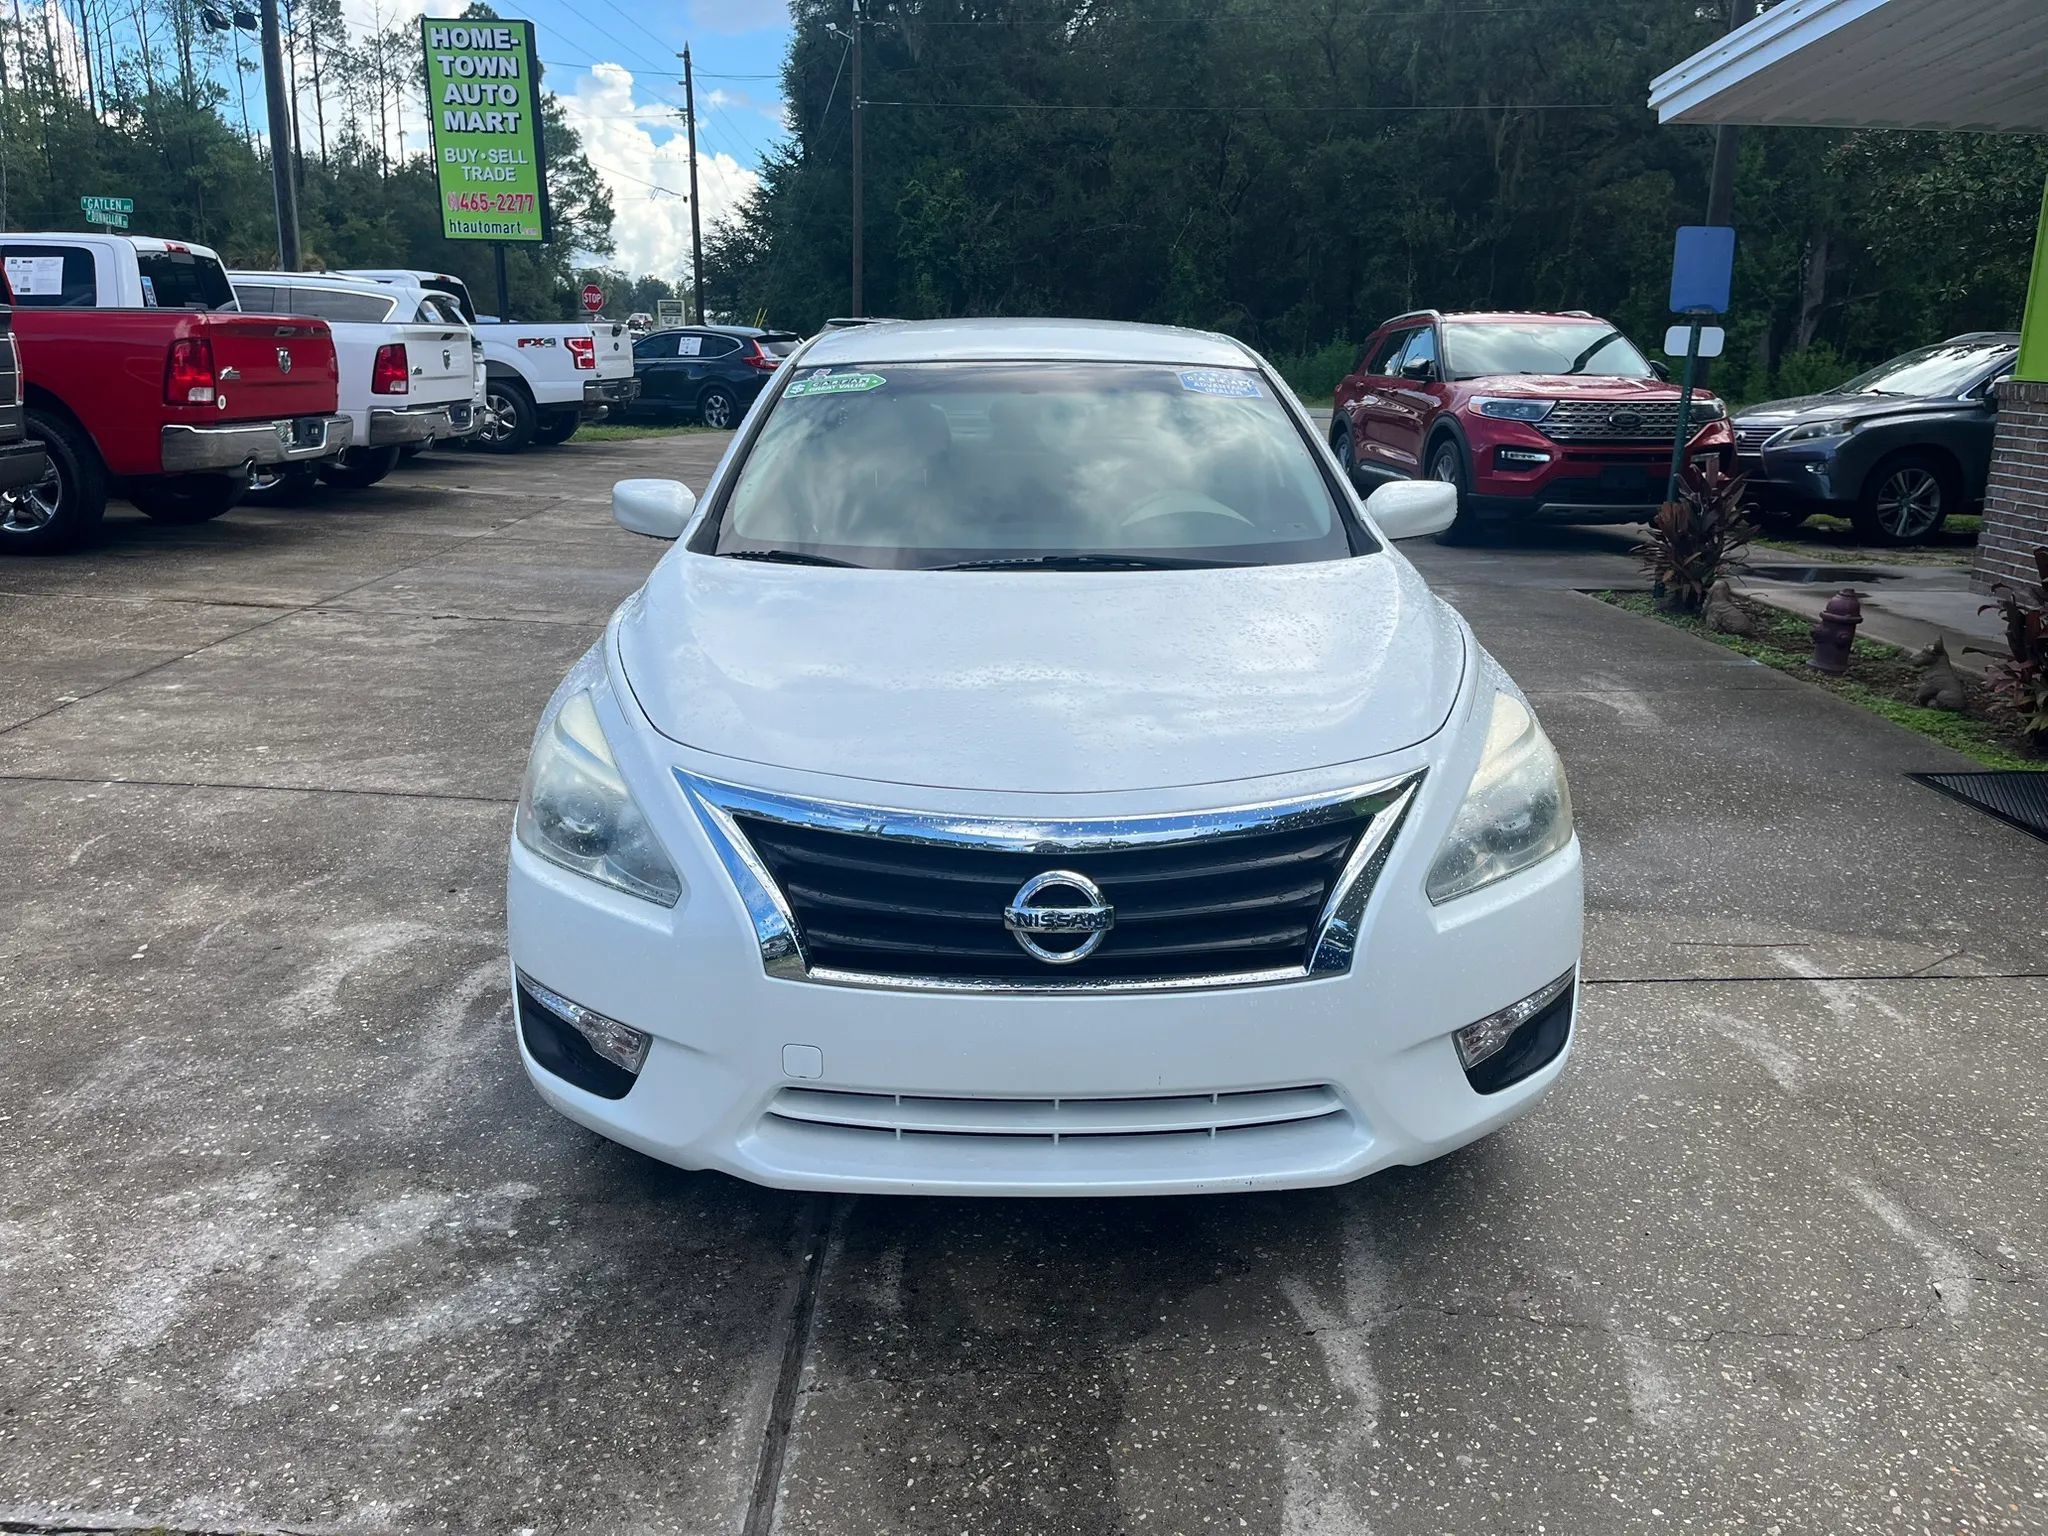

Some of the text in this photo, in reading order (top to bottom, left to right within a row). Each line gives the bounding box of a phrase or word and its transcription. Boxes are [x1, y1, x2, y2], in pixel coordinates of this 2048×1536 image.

[430, 27, 520, 50] HOME-
[437, 55, 519, 78] TOWN
[443, 83, 518, 106] AUTO
[443, 110, 521, 134] MART
[461, 166, 517, 182] TRADE
[88, 199, 121, 210] GATLEN
[583, 292, 602, 304] STOP
[517, 337, 557, 348] FX4
[1014, 911, 1106, 928] NISSAN
